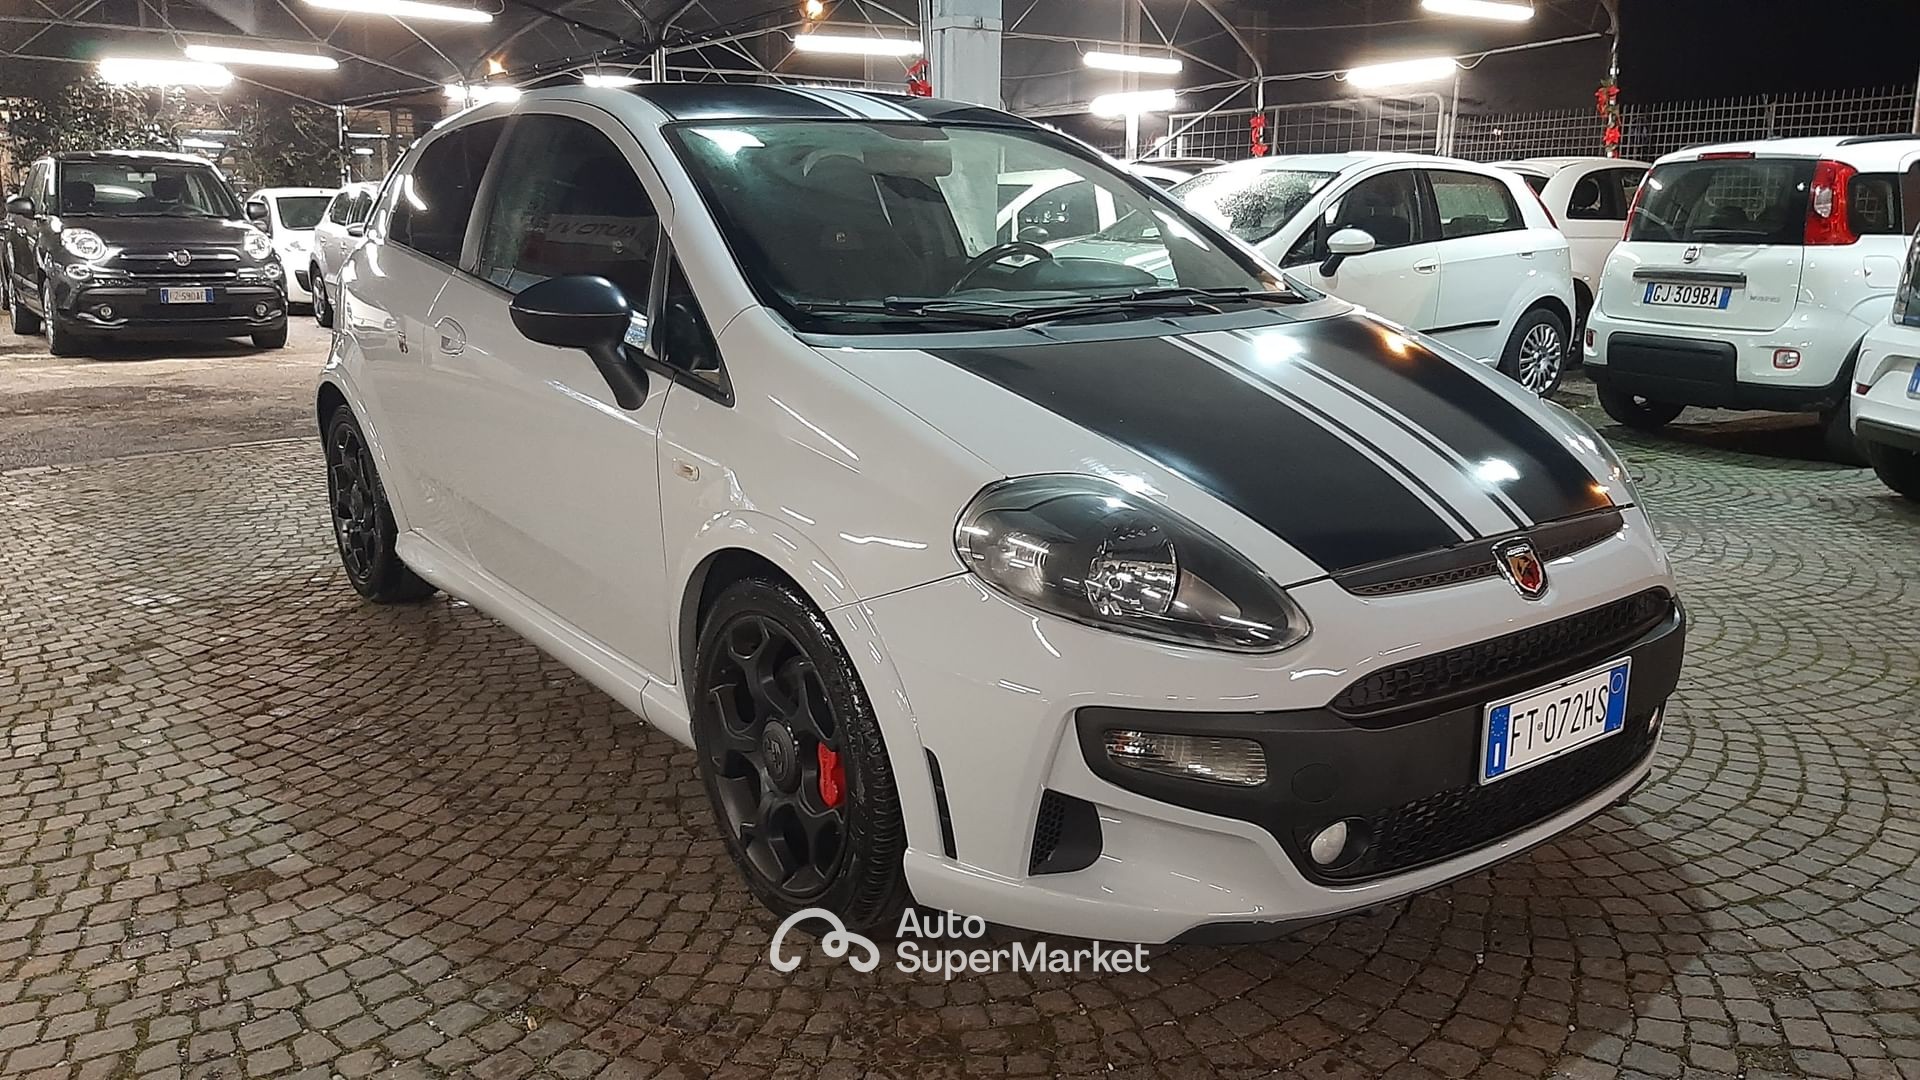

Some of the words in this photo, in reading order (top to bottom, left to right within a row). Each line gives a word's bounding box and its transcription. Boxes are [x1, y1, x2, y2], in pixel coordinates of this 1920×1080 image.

[1653, 285, 1672, 302] GJ
[1674, 286, 1719, 306] 309BA
[1510, 708, 1539, 757] FT
[1544, 685, 1608, 743] 072HS
[1494, 742, 1500, 767] I
